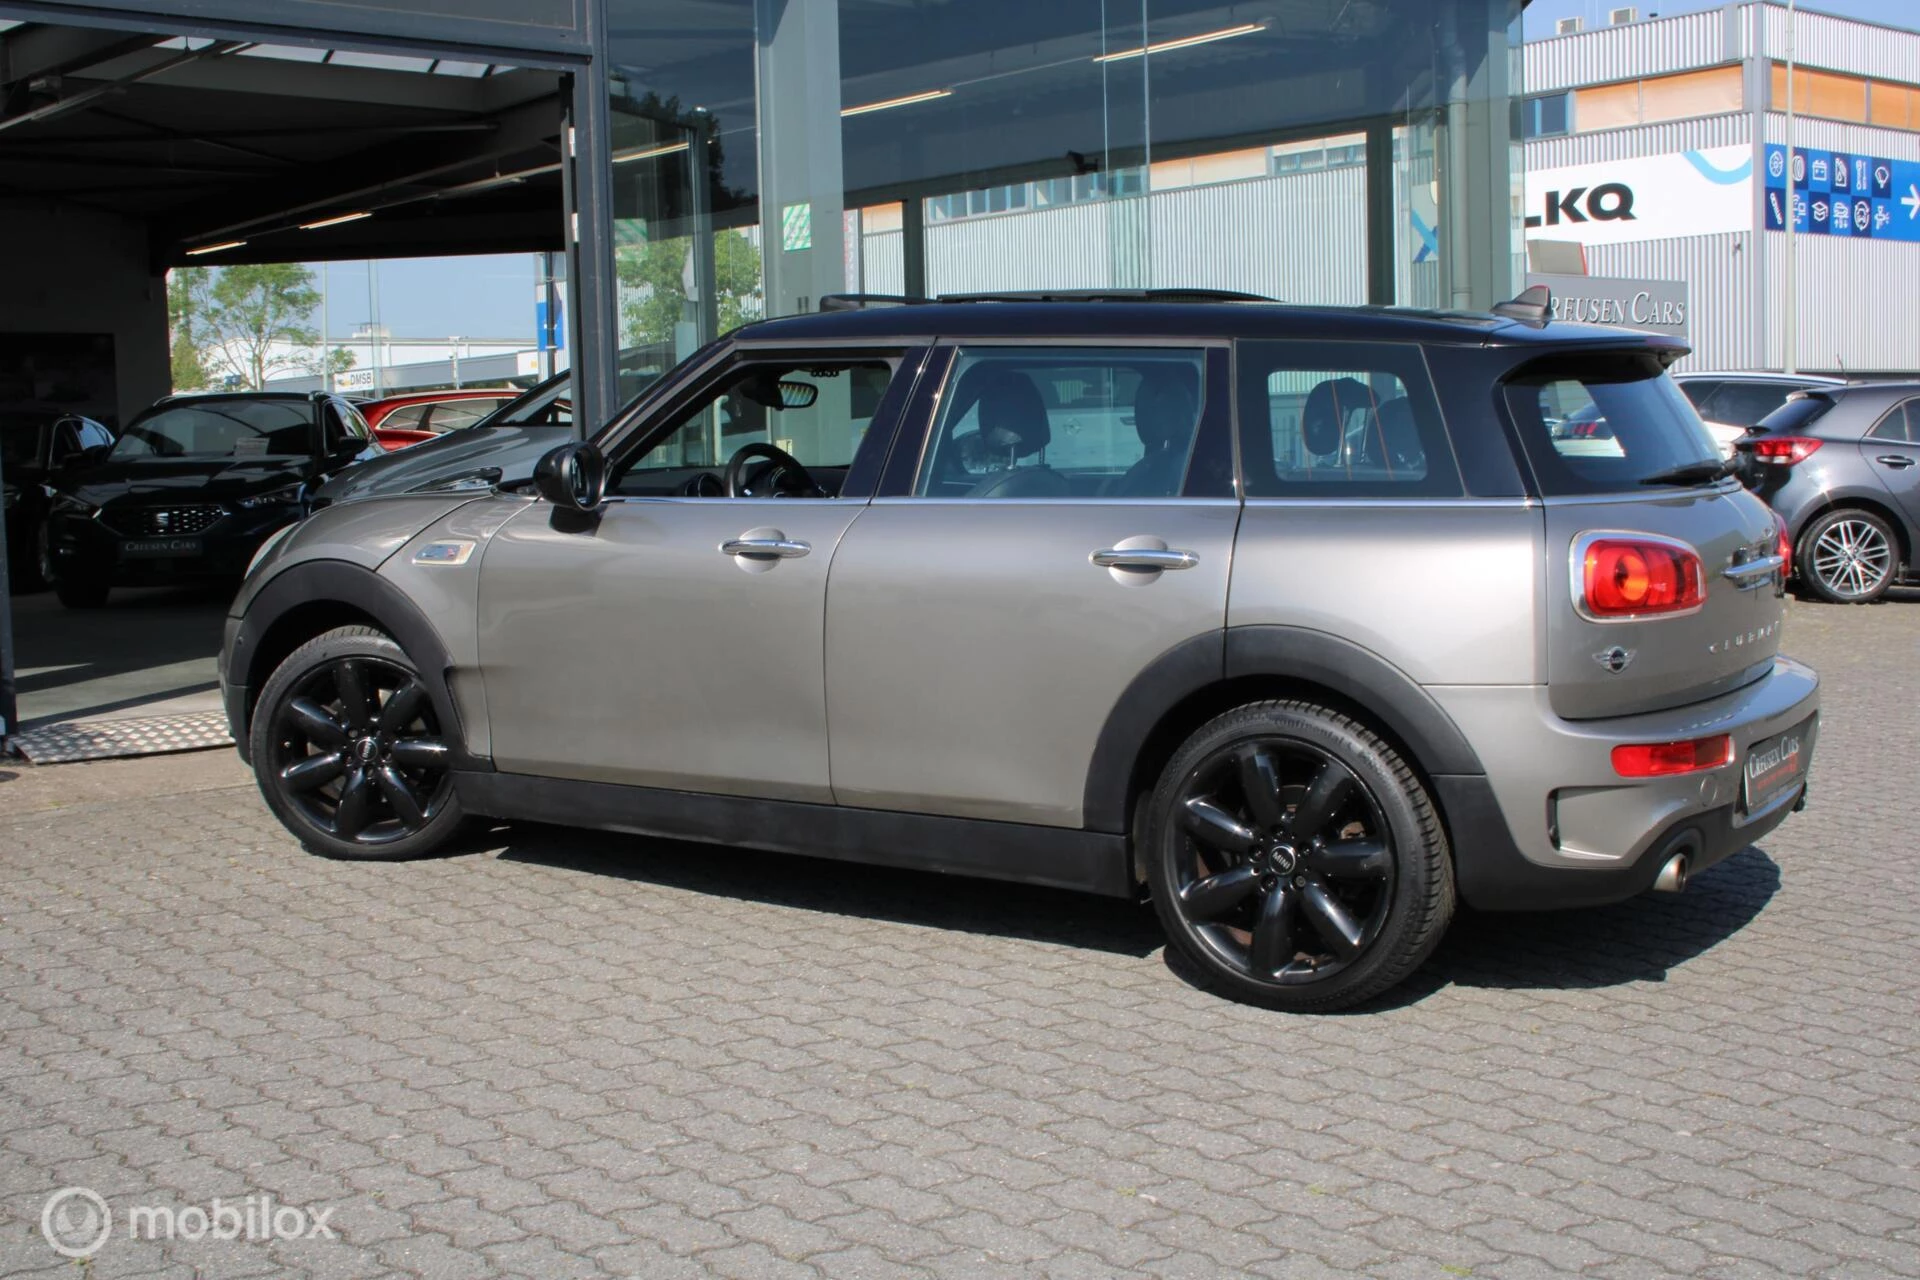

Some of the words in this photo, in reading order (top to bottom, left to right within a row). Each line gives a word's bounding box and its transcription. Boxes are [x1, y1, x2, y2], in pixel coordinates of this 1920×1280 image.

[1550, 296, 1627, 323] REUSEN
[1631, 291, 1685, 325] CARS
[1272, 851, 1291, 869] MINI
